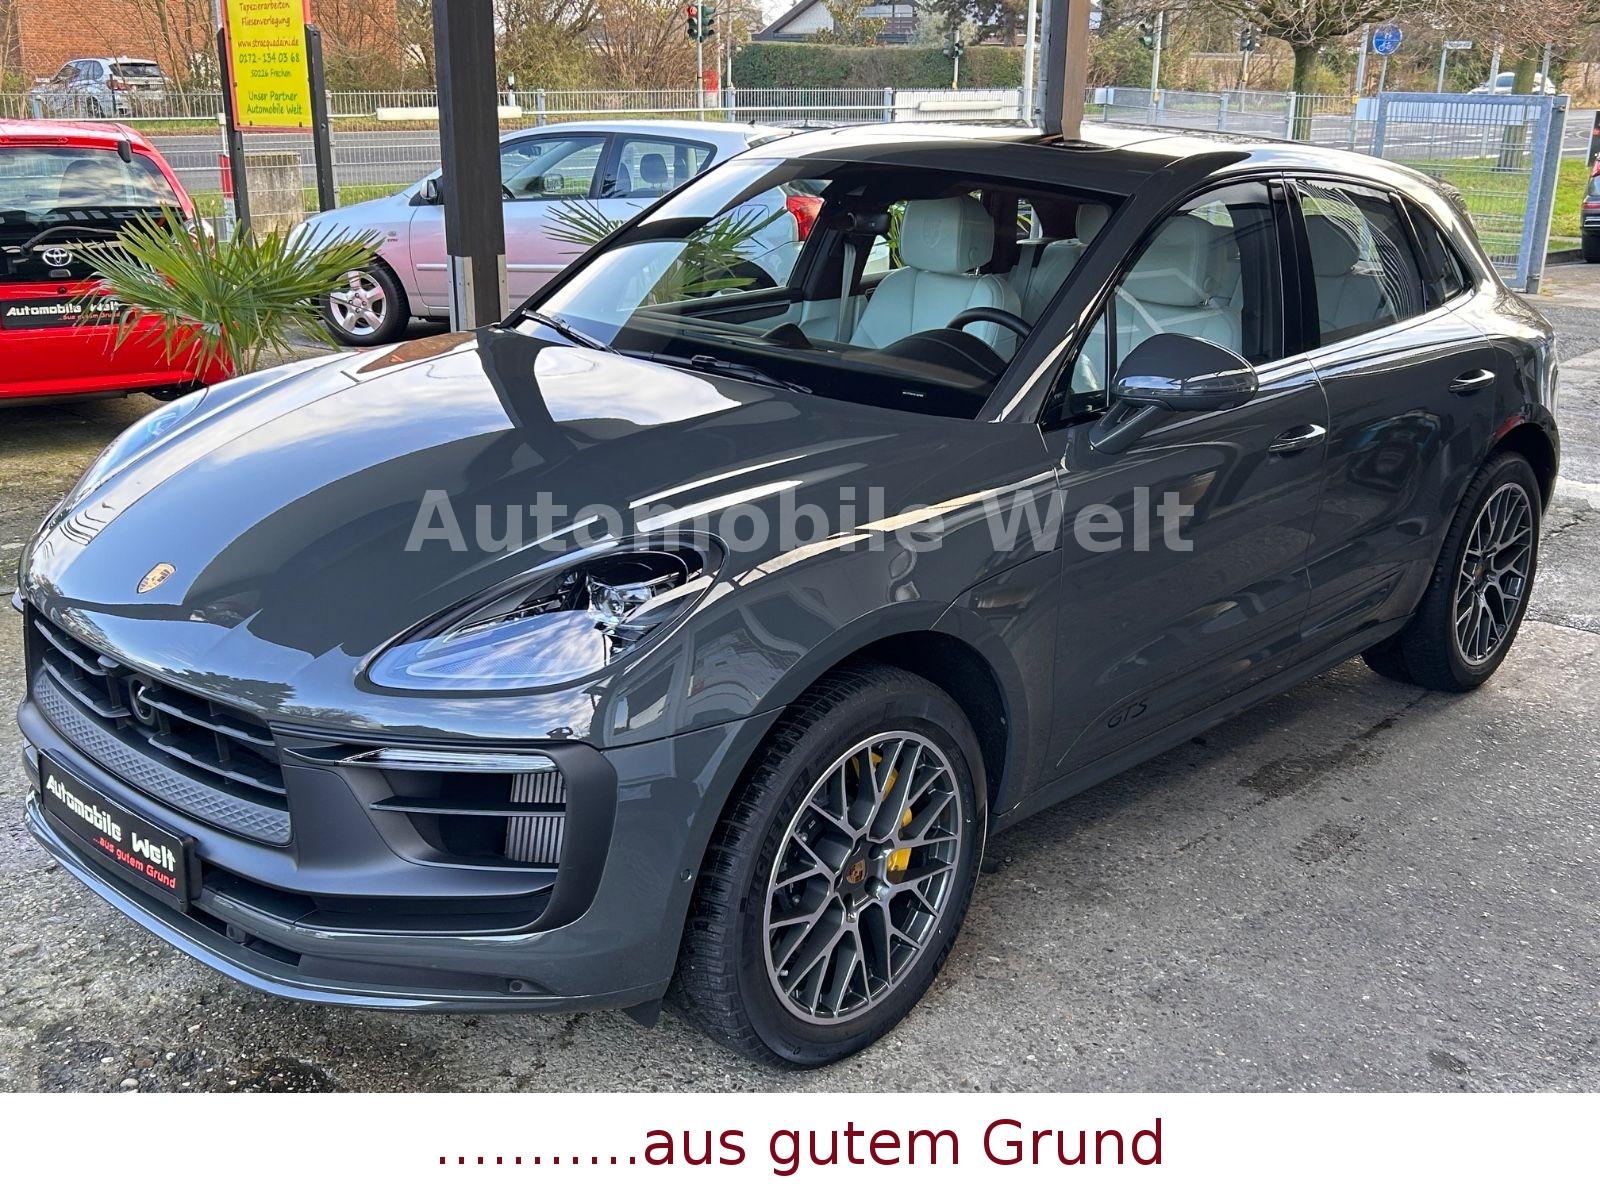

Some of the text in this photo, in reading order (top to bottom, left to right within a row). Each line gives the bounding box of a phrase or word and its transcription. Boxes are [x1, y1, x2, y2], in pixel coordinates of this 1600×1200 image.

[239, 53, 257, 63] 0172
[262, 53, 276, 63] 134
[278, 53, 288, 63] 03
[290, 53, 300, 63] 68
[270, 68, 291, 78] Frechen
[248, 91, 298, 101] Unser Partner
[247, 103, 303, 115] Automobile Welt
[6, 303, 82, 317] Automobile
[1106, 697, 1149, 729] GTS
[46, 774, 177, 873] Automobile Welt
[116, 848, 144, 872] gutem
[146, 864, 177, 890] Grund
